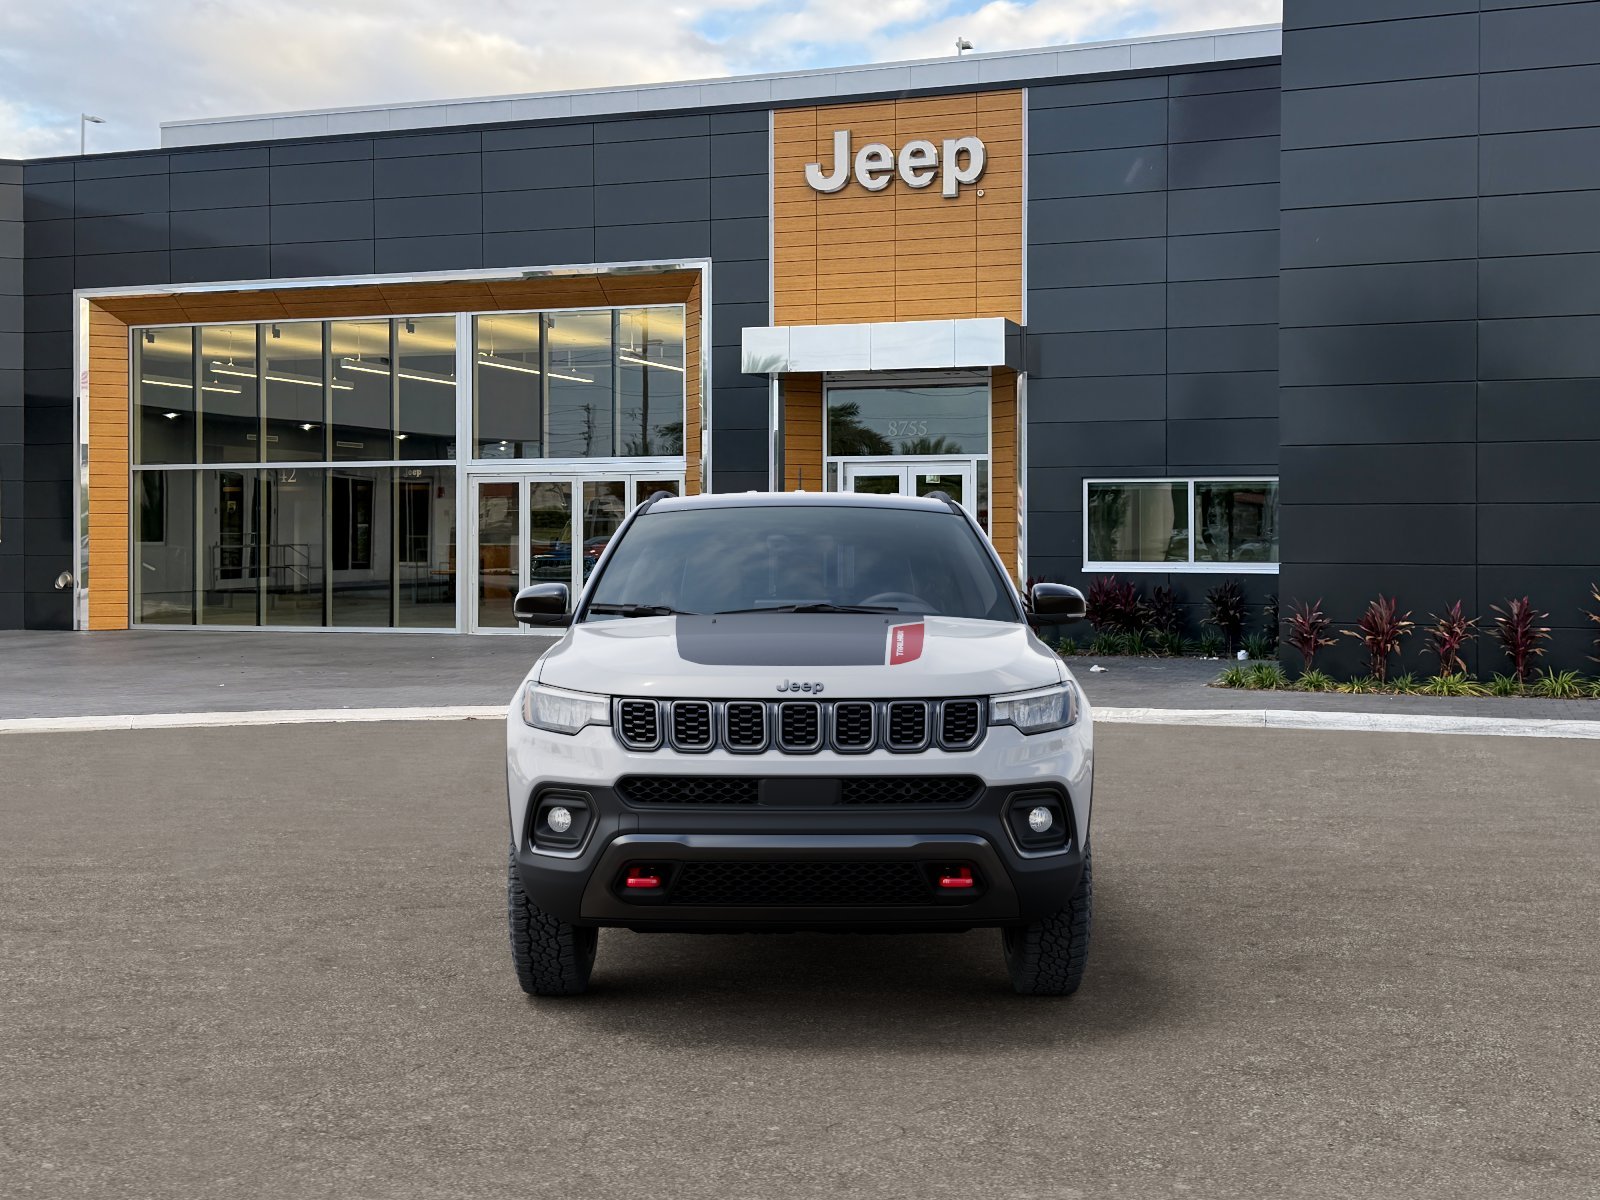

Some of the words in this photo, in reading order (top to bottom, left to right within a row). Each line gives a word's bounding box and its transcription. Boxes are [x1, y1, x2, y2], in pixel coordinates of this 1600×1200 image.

[805, 129, 987, 198] Jeep
[888, 420, 928, 437] 8755
[776, 679, 825, 695] Jeep
